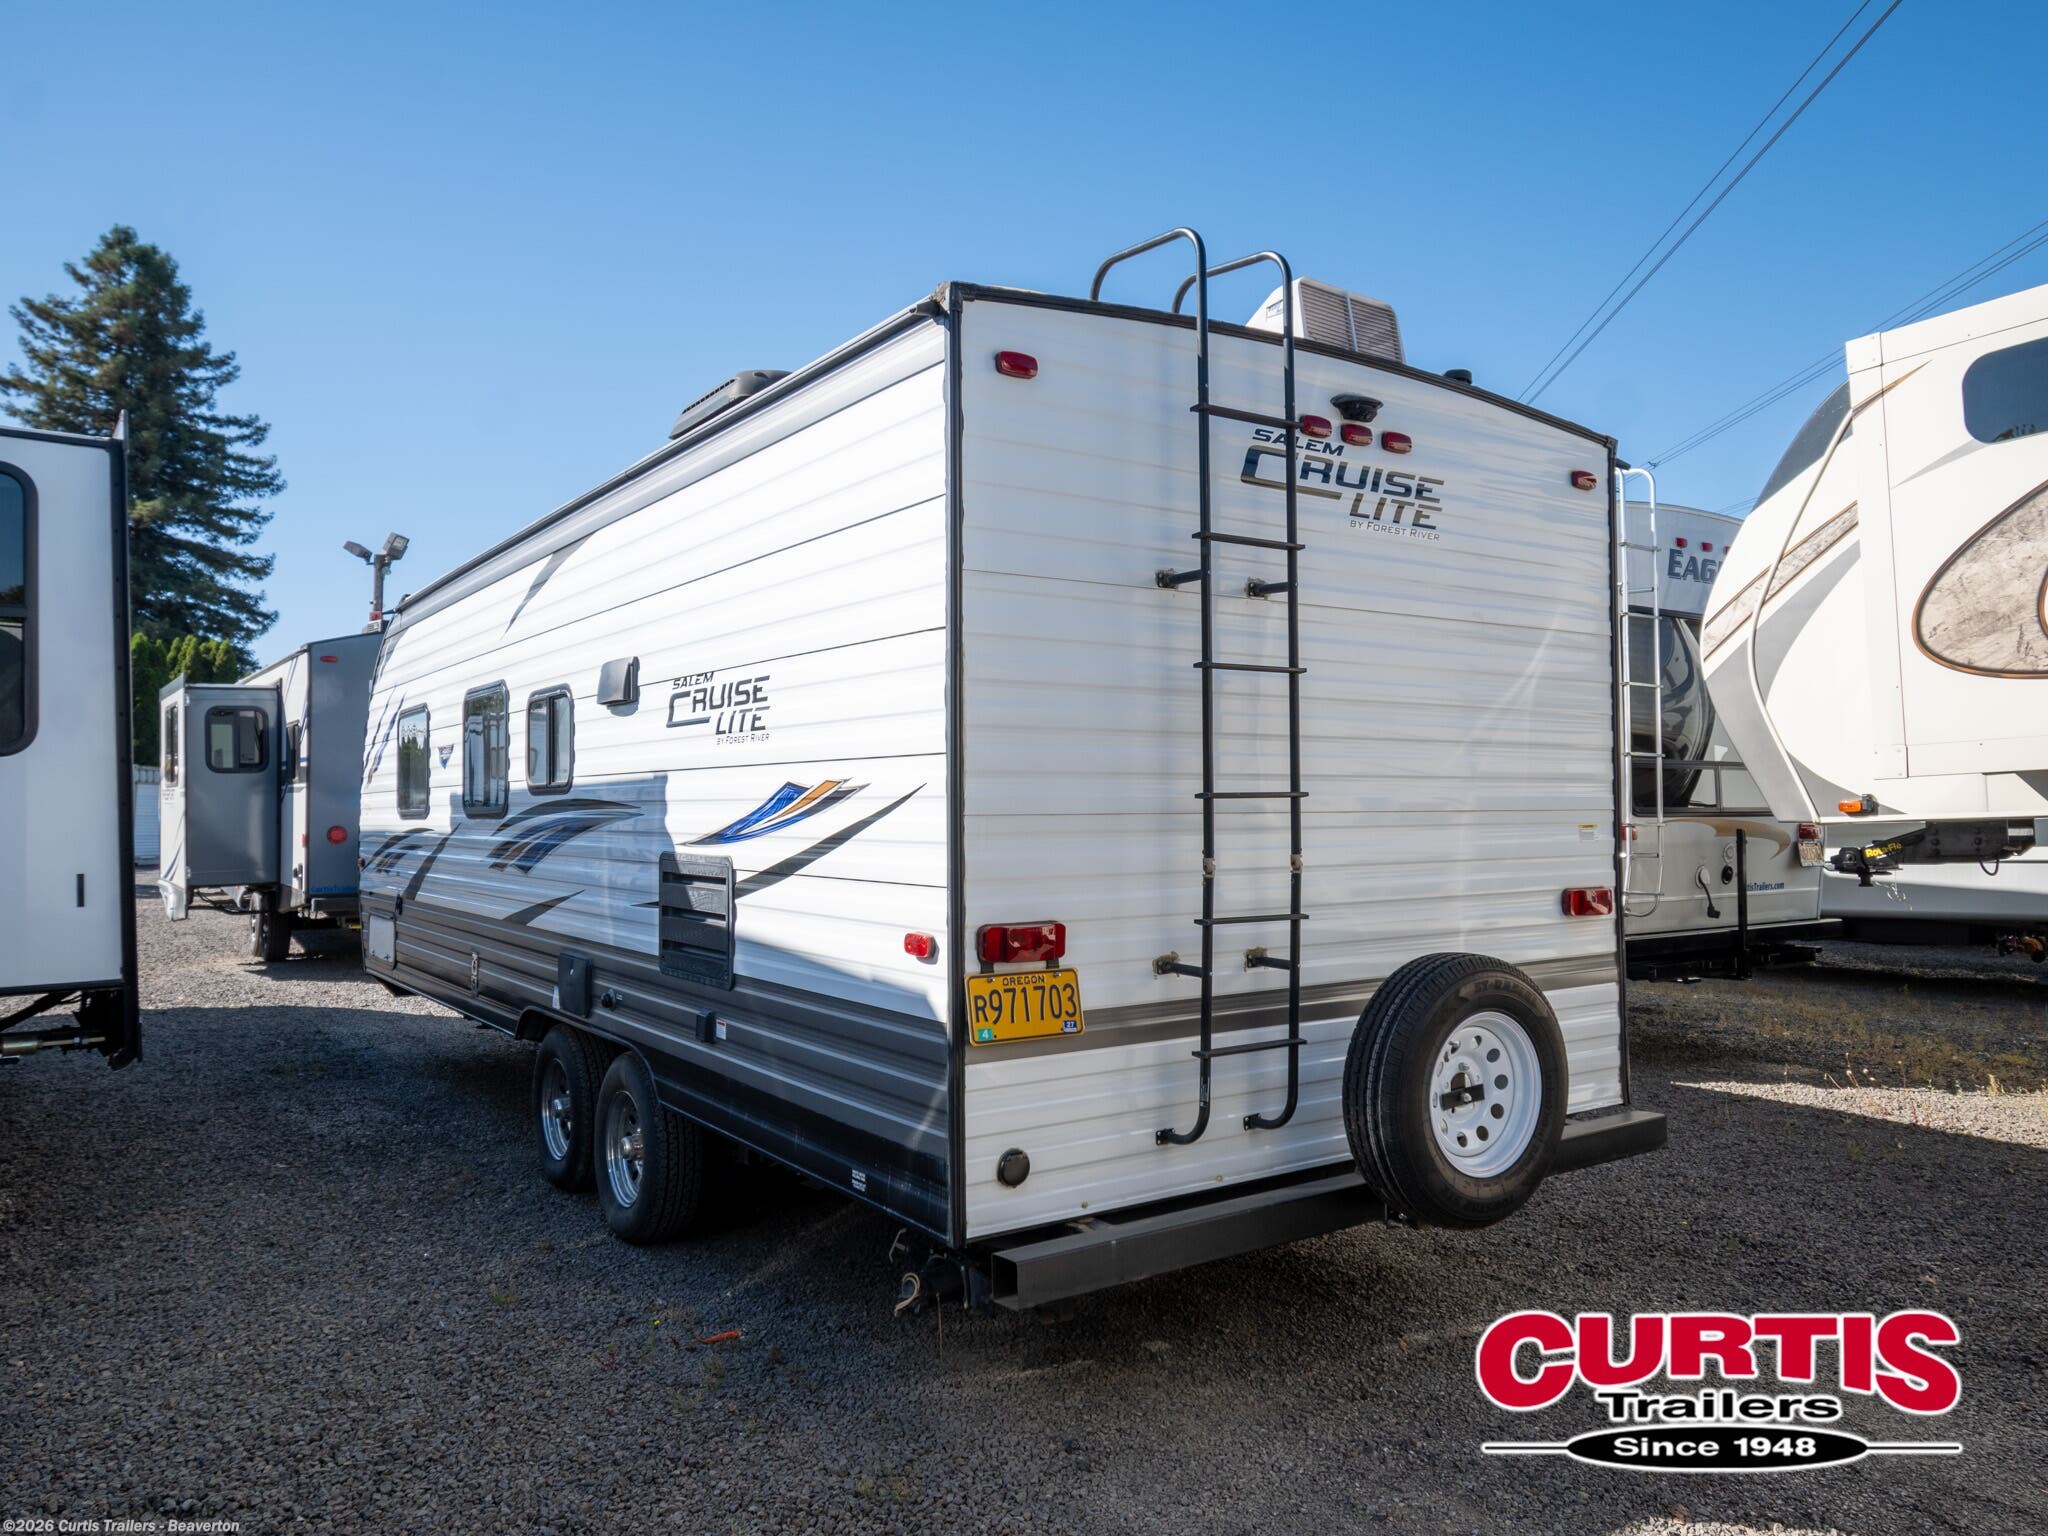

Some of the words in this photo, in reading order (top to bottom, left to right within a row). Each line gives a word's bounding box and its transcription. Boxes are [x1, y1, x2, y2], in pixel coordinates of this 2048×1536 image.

[1252, 428, 1344, 456] SALEM
[1240, 445, 1444, 504] CRUISE
[1350, 493, 1443, 530] LITE
[1350, 520, 1364, 529] BY
[672, 671, 714, 690] SALEM
[666, 675, 770, 728] CRUISE
[715, 706, 771, 735] LITE
[1002, 975, 1045, 986] OREGON
[973, 983, 1078, 1025] R971703
